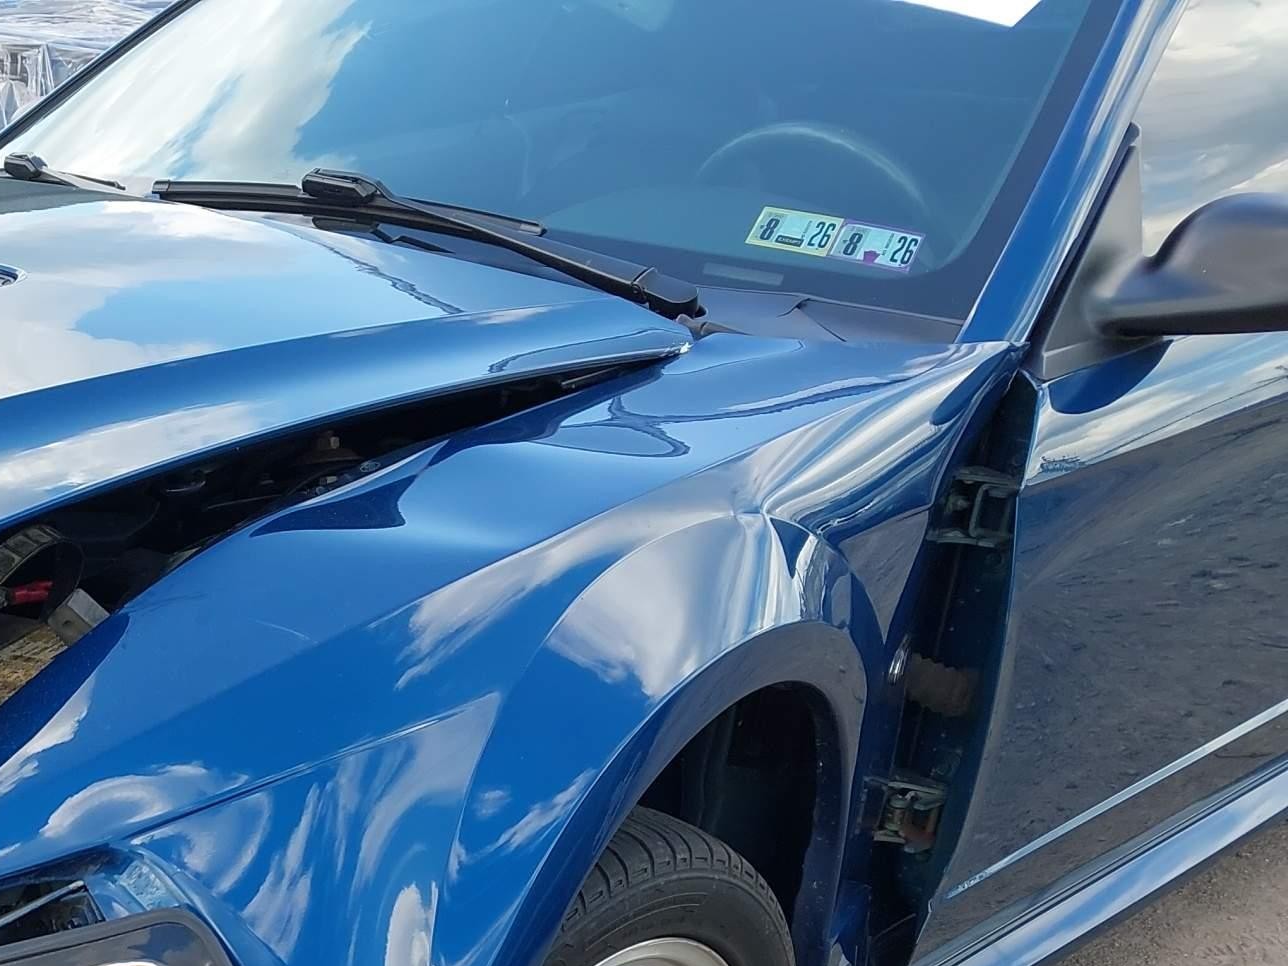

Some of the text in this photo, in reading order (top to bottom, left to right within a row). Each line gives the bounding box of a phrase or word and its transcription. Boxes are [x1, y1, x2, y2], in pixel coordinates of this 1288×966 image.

[759, 218, 781, 241] 8
[807, 221, 837, 249] 26
[843, 232, 864, 256] 8
[889, 235, 919, 265] 26
